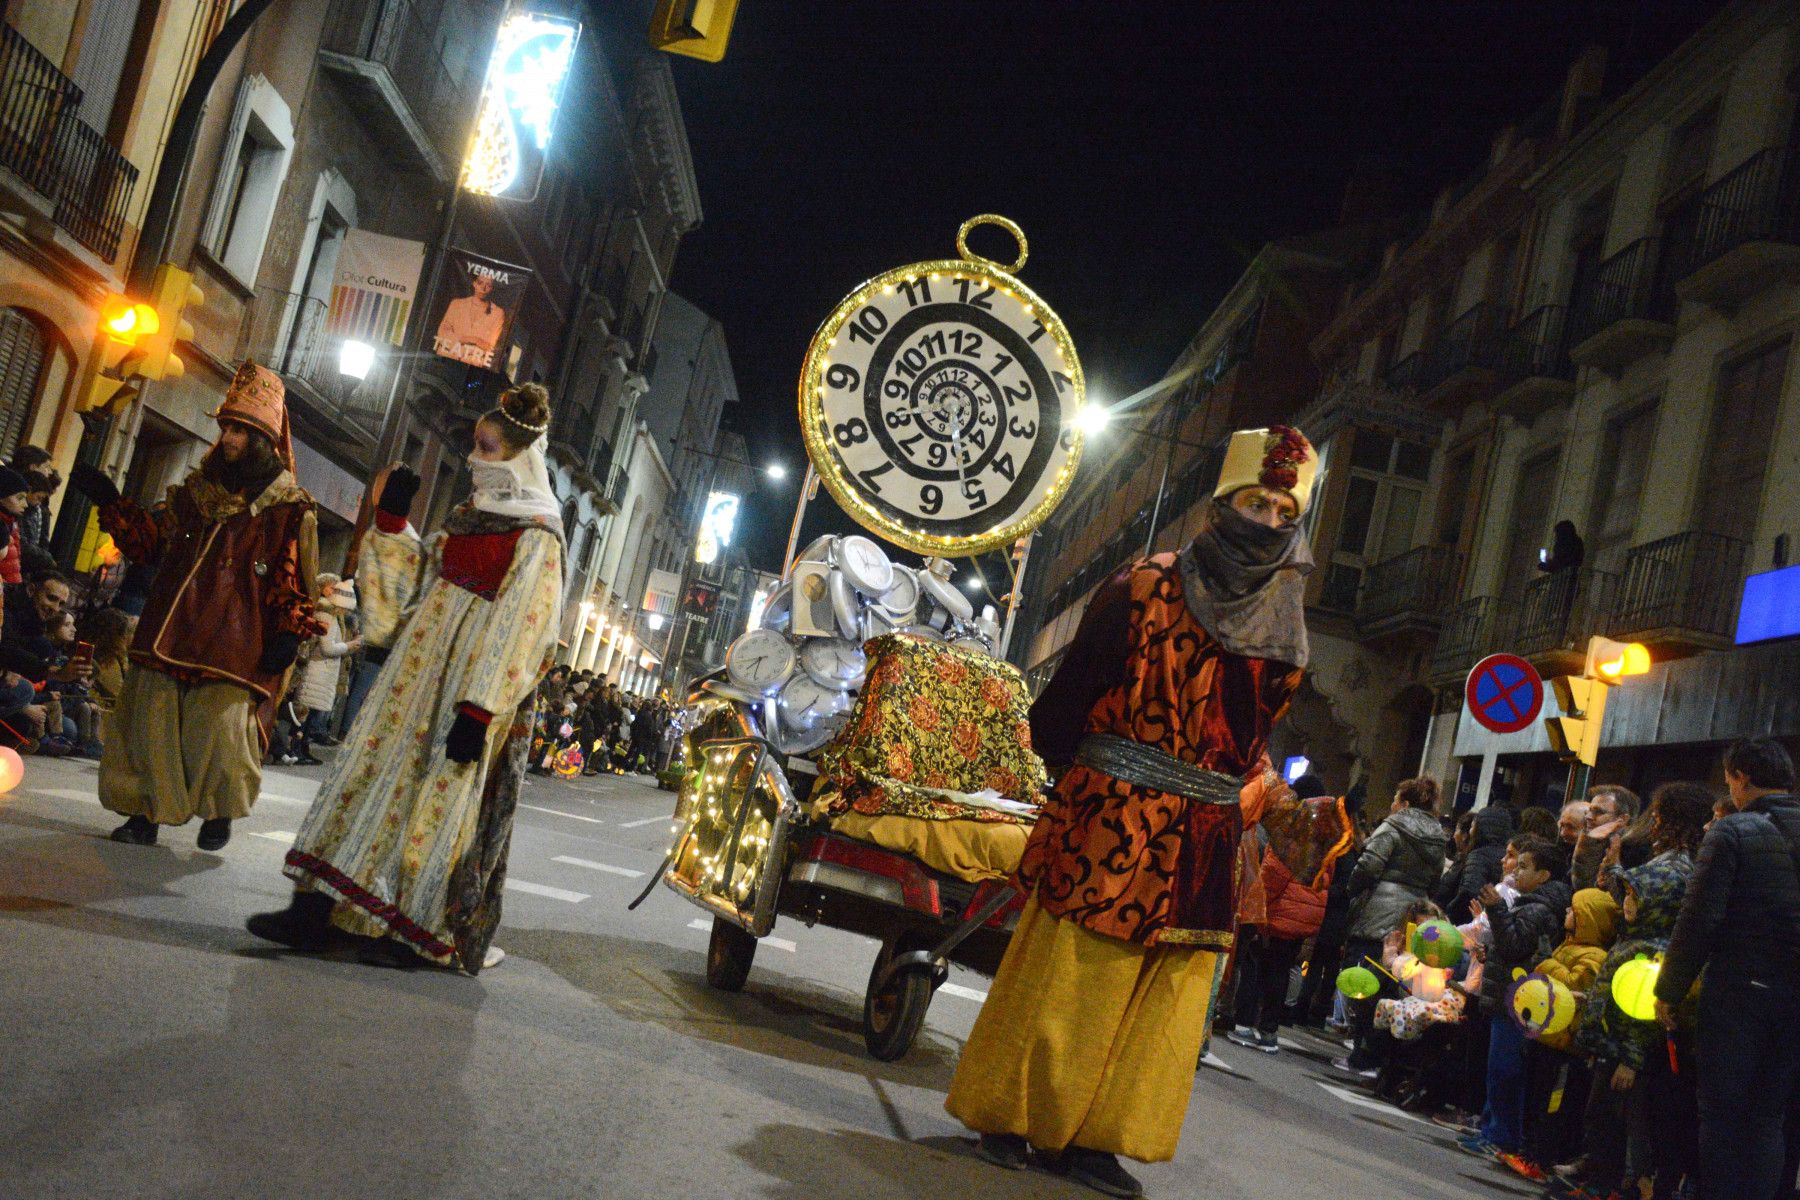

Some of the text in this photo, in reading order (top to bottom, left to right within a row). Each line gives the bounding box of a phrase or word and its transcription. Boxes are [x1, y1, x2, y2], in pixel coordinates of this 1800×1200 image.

[367, 275, 407, 293] Cultura
[467, 261, 509, 285] YERMA
[897, 277, 932, 307] 11
[952, 278, 995, 310] 12
[849, 305, 888, 345] 10
[433, 335, 495, 368] TEATRE
[918, 330, 947, 358] 11
[948, 330, 983, 358] 12
[895, 351, 926, 380] 10
[936, 370, 949, 382] 11
[951, 369, 968, 384] 12
[991, 352, 1013, 377] 1
[826, 363, 860, 393] 9
[884, 379, 910, 400] 9
[924, 379, 936, 390] 10
[971, 380, 983, 391] 1
[978, 394, 992, 406] 2
[1003, 380, 1031, 406] 2
[886, 407, 911, 429] 8
[979, 410, 996, 427] 3
[1009, 416, 1036, 440] 3
[833, 417, 868, 448] 8
[898, 433, 924, 457] 7
[967, 429, 986, 450] 4
[927, 443, 947, 468] 6
[990, 451, 1016, 482] 4
[859, 461, 895, 494] 7
[918, 484, 944, 516] 6
[964, 479, 987, 510] 5
[685, 612, 709, 624] TEATRE
